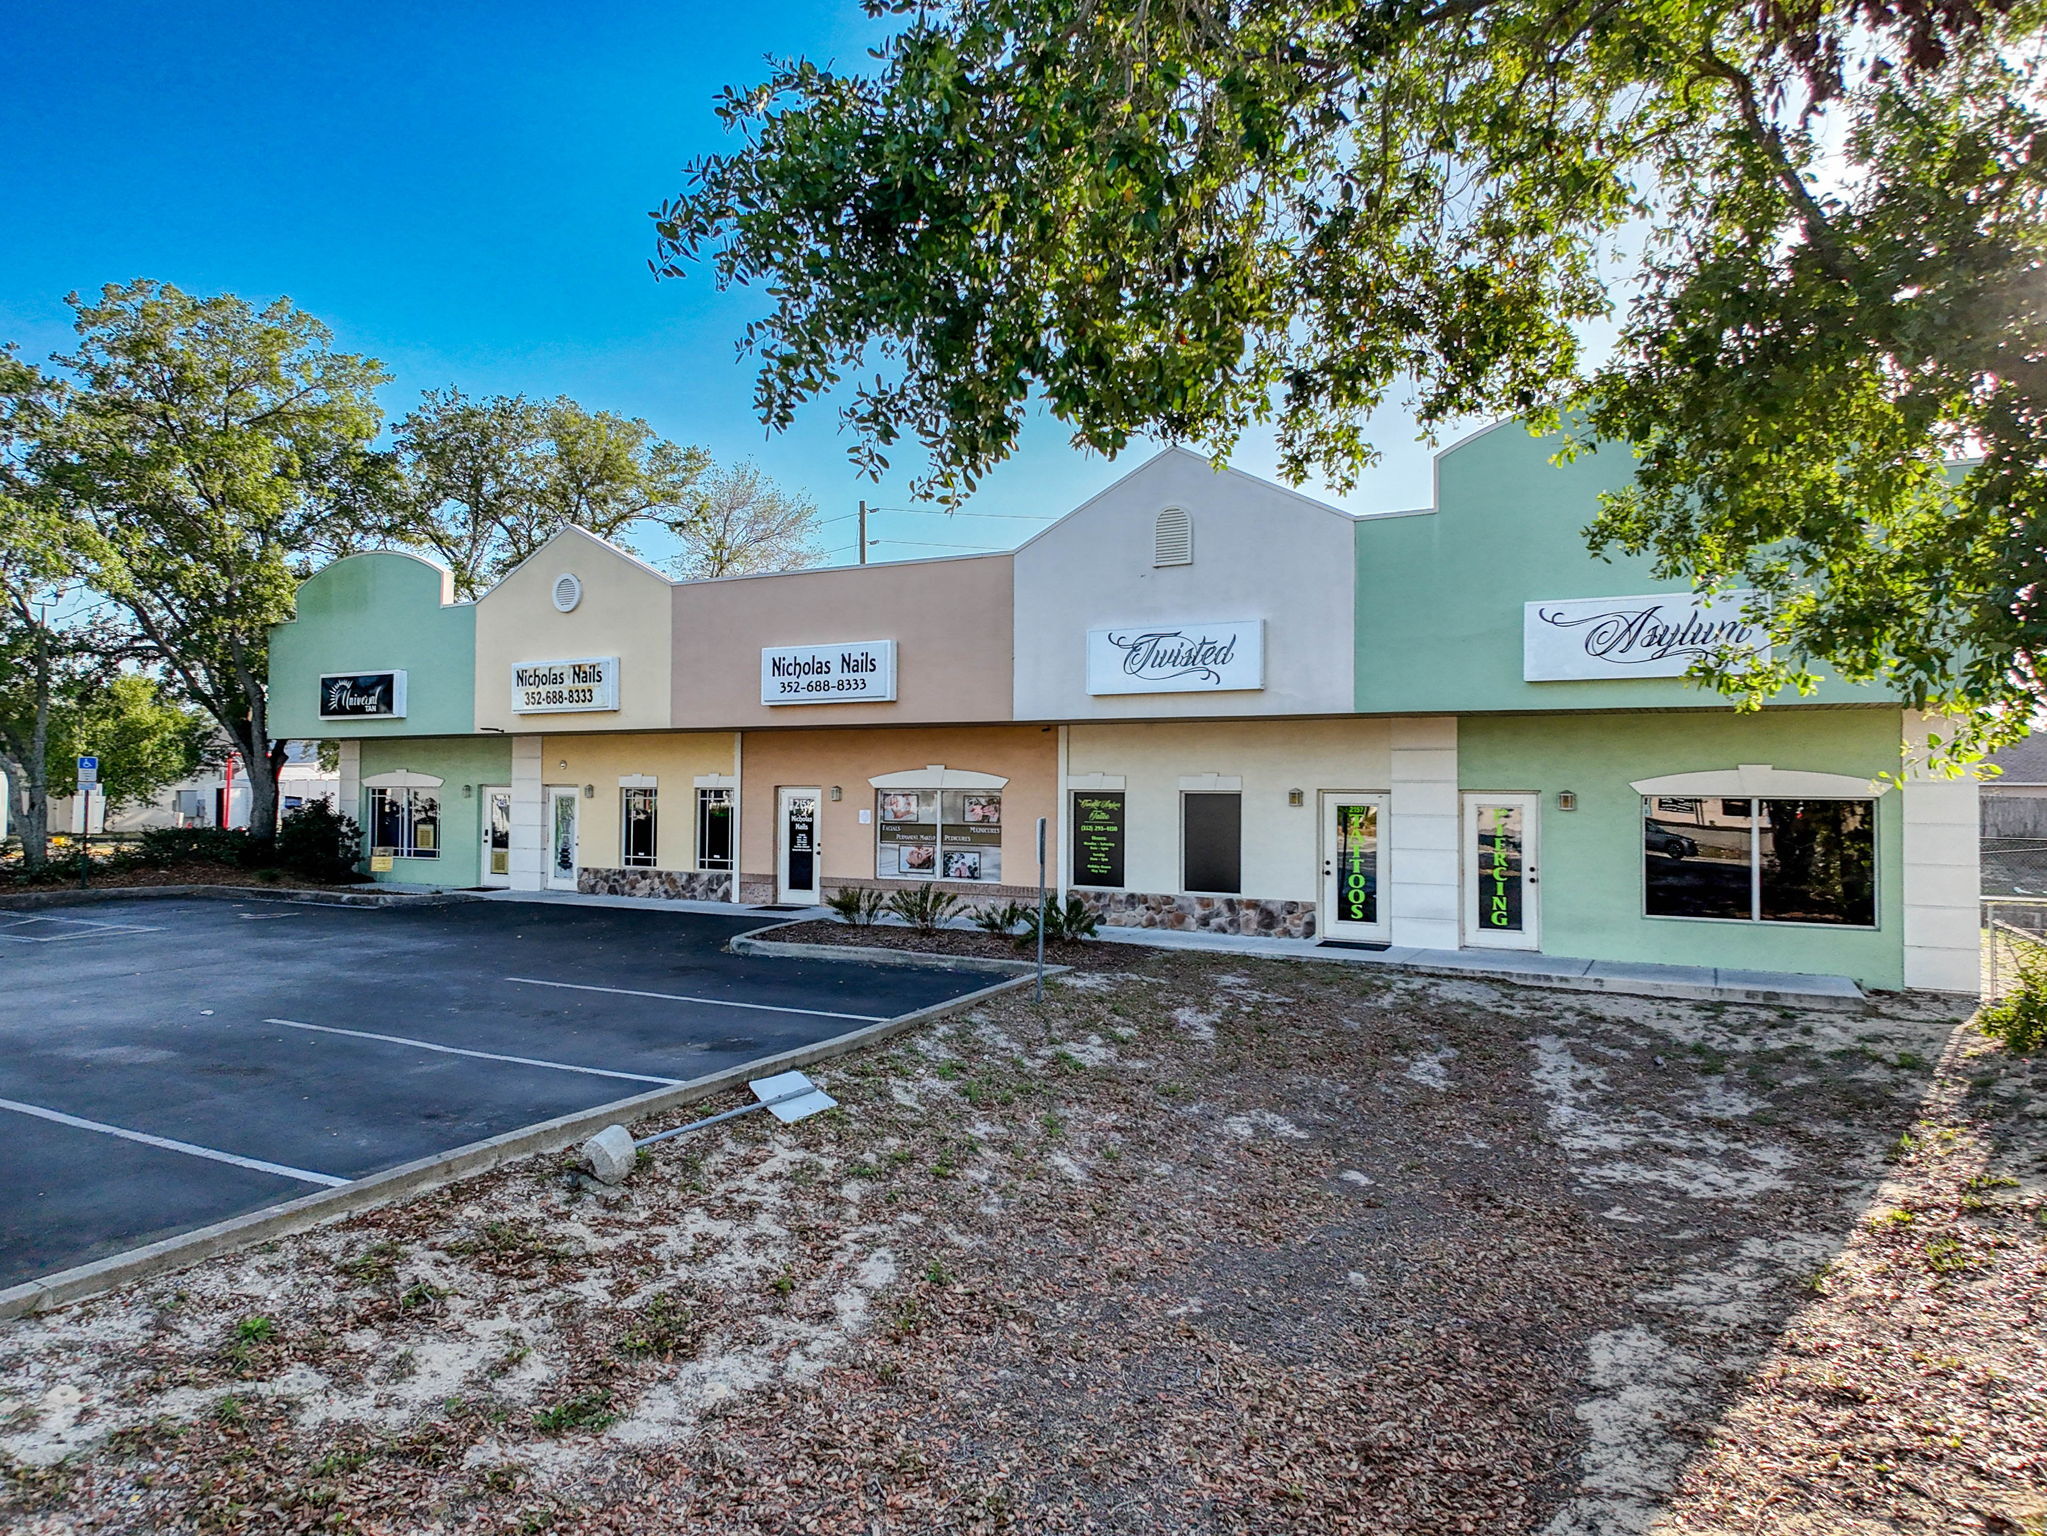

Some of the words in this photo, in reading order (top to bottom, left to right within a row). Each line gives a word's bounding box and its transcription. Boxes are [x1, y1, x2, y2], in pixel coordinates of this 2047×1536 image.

[1541, 605, 1753, 662] Asylum
[516, 667, 564, 688] Nicholas
[572, 664, 603, 684] Nails
[772, 655, 831, 679] Nicholas
[840, 651, 877, 674] Nails
[1108, 631, 1236, 684] Twisted
[524, 688, 593, 706] 352-688-8333
[780, 678, 867, 694] 352-688-8333
[1348, 814, 1366, 919] TATTOOS
[1490, 808, 1509, 926] PIERCING
